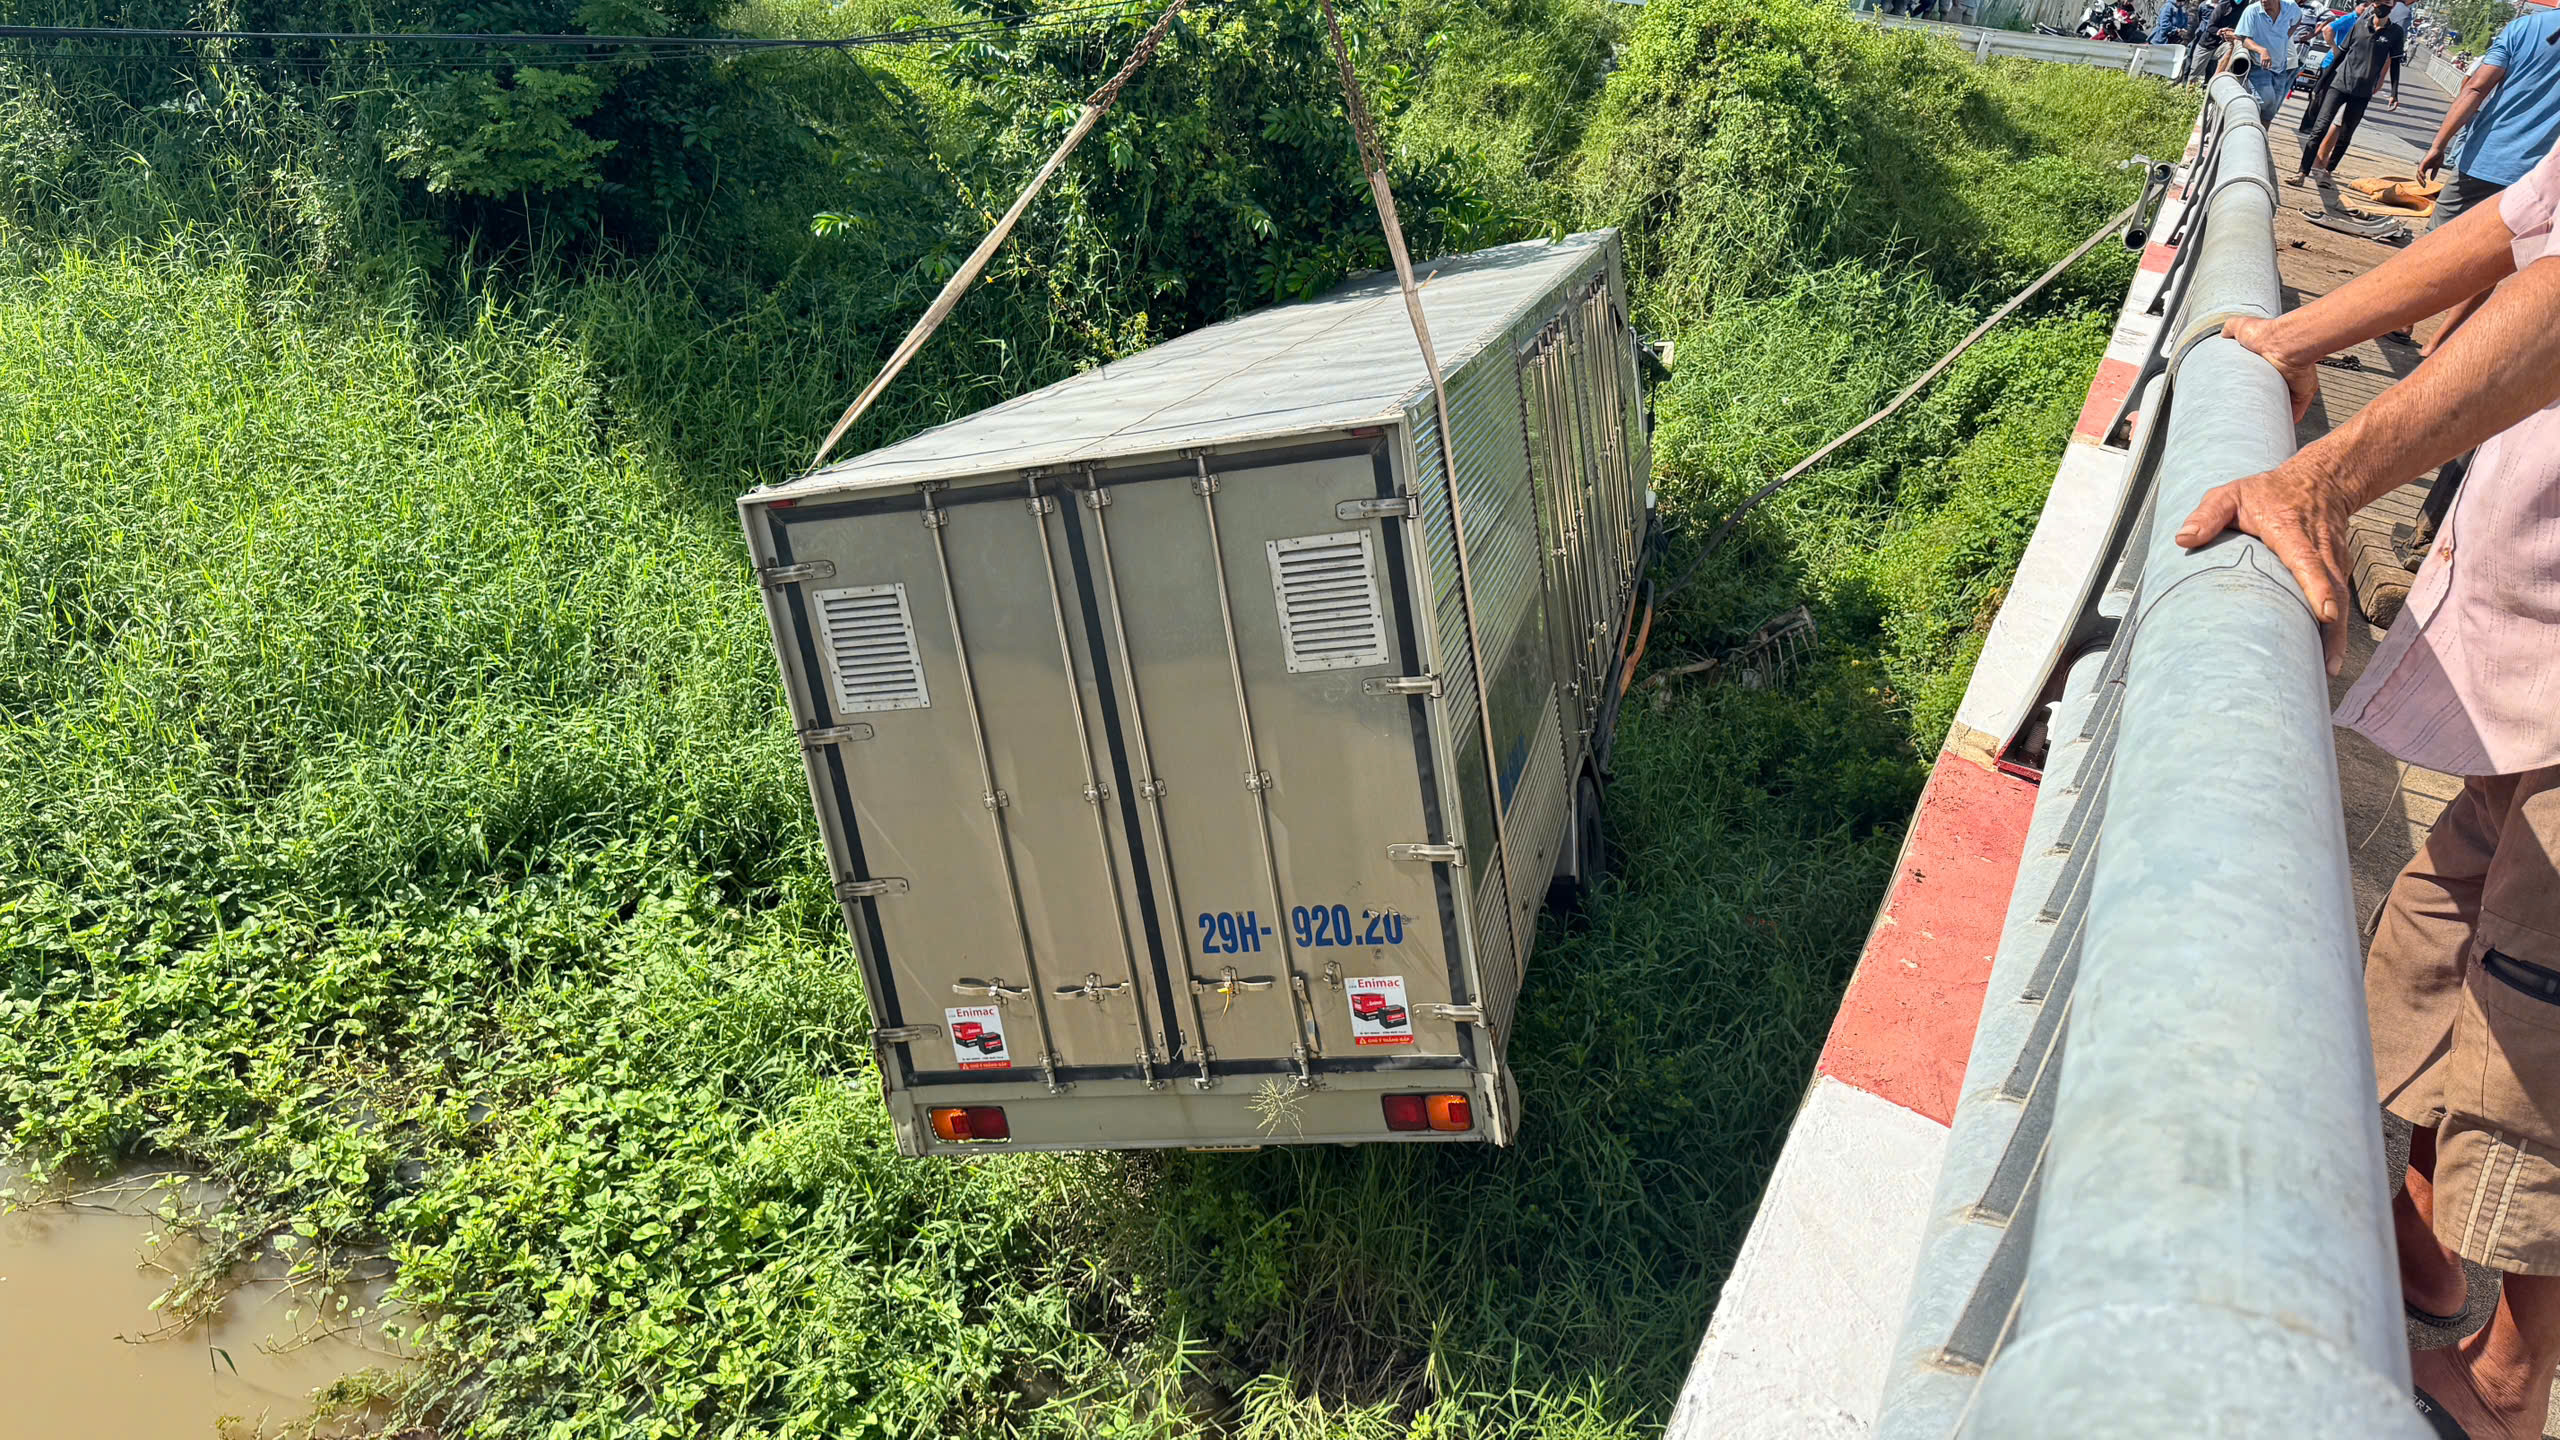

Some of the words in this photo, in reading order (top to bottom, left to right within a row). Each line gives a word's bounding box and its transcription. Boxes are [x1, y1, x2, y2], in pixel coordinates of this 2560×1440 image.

[1199, 911, 1272, 954] 29H-
[1291, 904, 1404, 948] 920.20
[1357, 978, 1400, 988] Enimac
[956, 1008, 995, 1017] Enimac
